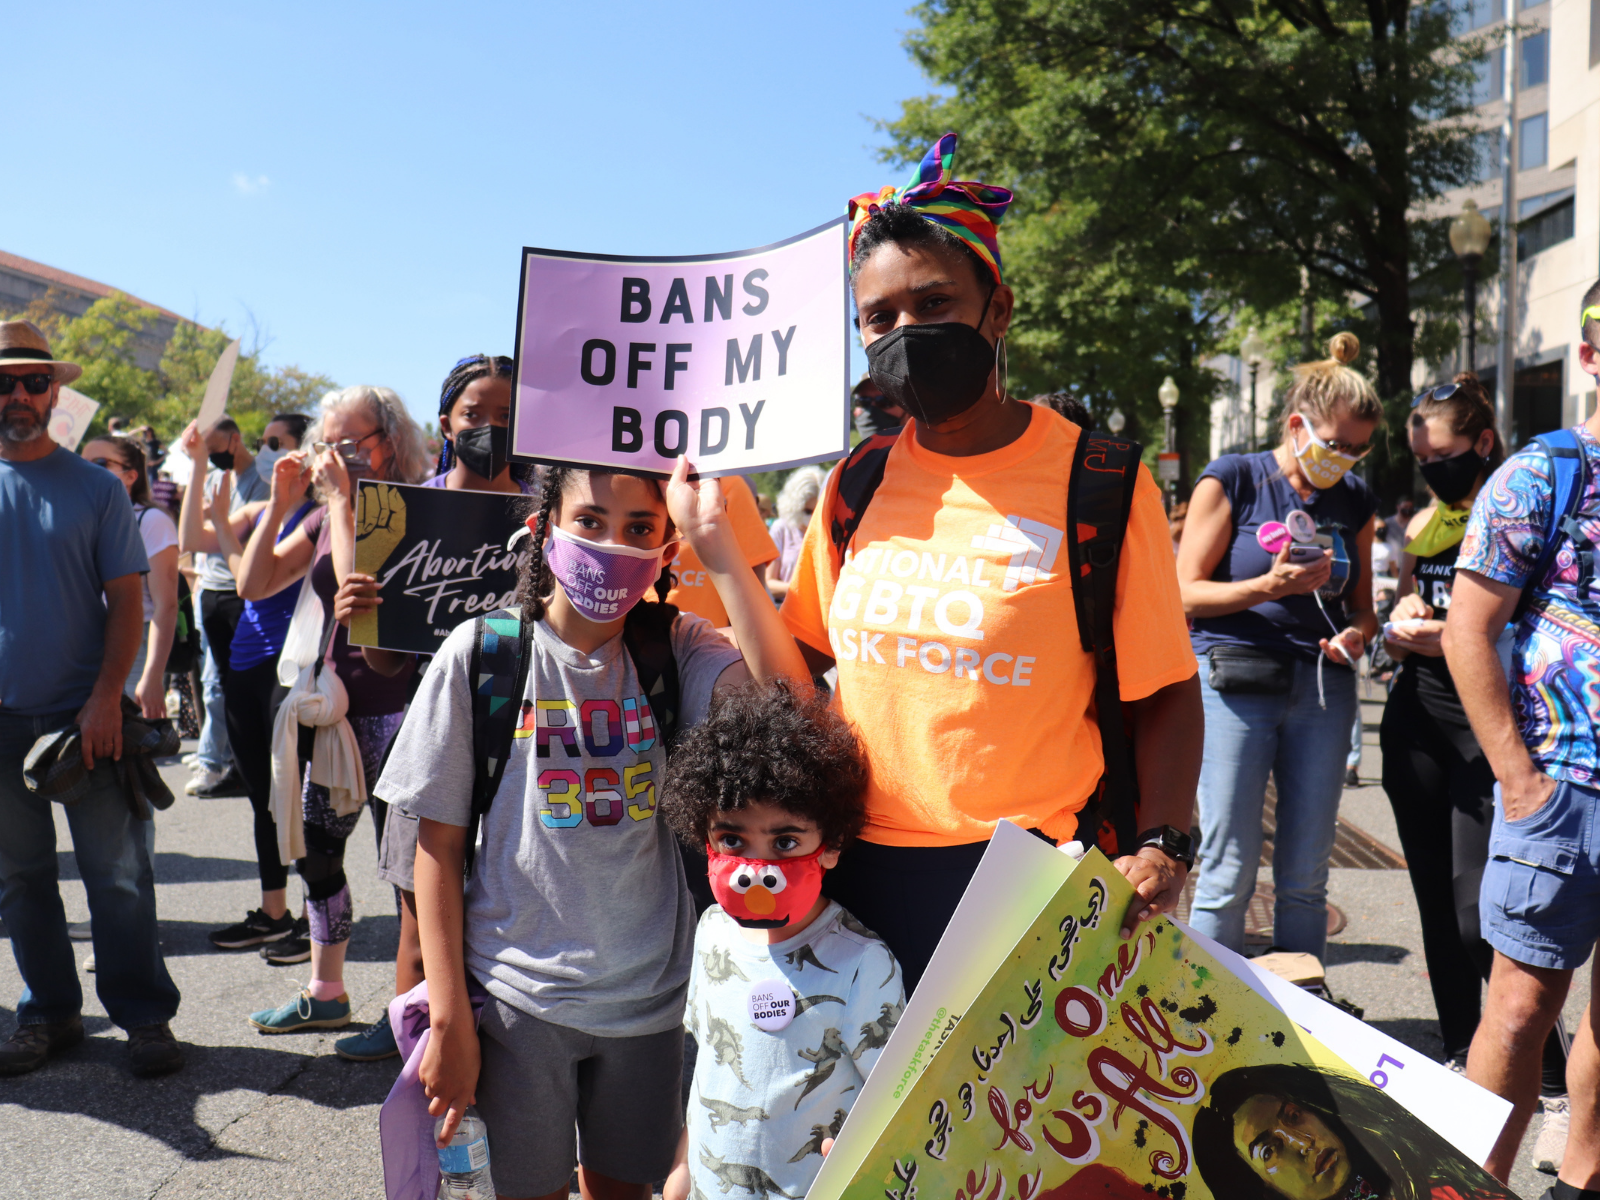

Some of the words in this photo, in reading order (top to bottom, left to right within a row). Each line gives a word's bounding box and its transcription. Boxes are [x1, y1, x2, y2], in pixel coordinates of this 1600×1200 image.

[619, 268, 770, 325] BANS
[580, 338, 693, 391] OFF
[724, 325, 797, 386] MY
[611, 400, 766, 459] BODY
[566, 573, 593, 594] OFF
[594, 586, 628, 601] OUR
[567, 560, 606, 584] BANS
[828, 574, 985, 641] GBTQ
[828, 627, 886, 665] ASK
[896, 635, 1036, 687] FORCE
[537, 761, 656, 828] 365
[751, 993, 774, 1003] BANS
[752, 1002, 769, 1011] OFF
[770, 1000, 790, 1009] OUR
[754, 1009, 787, 1020] BODIES
[893, 1007, 947, 1099] @thetaskforce
[987, 1063, 1054, 1153] for
[1054, 930, 1156, 1038] One,
[1042, 1089, 1103, 1161] Us
[1086, 996, 1207, 1181] All
